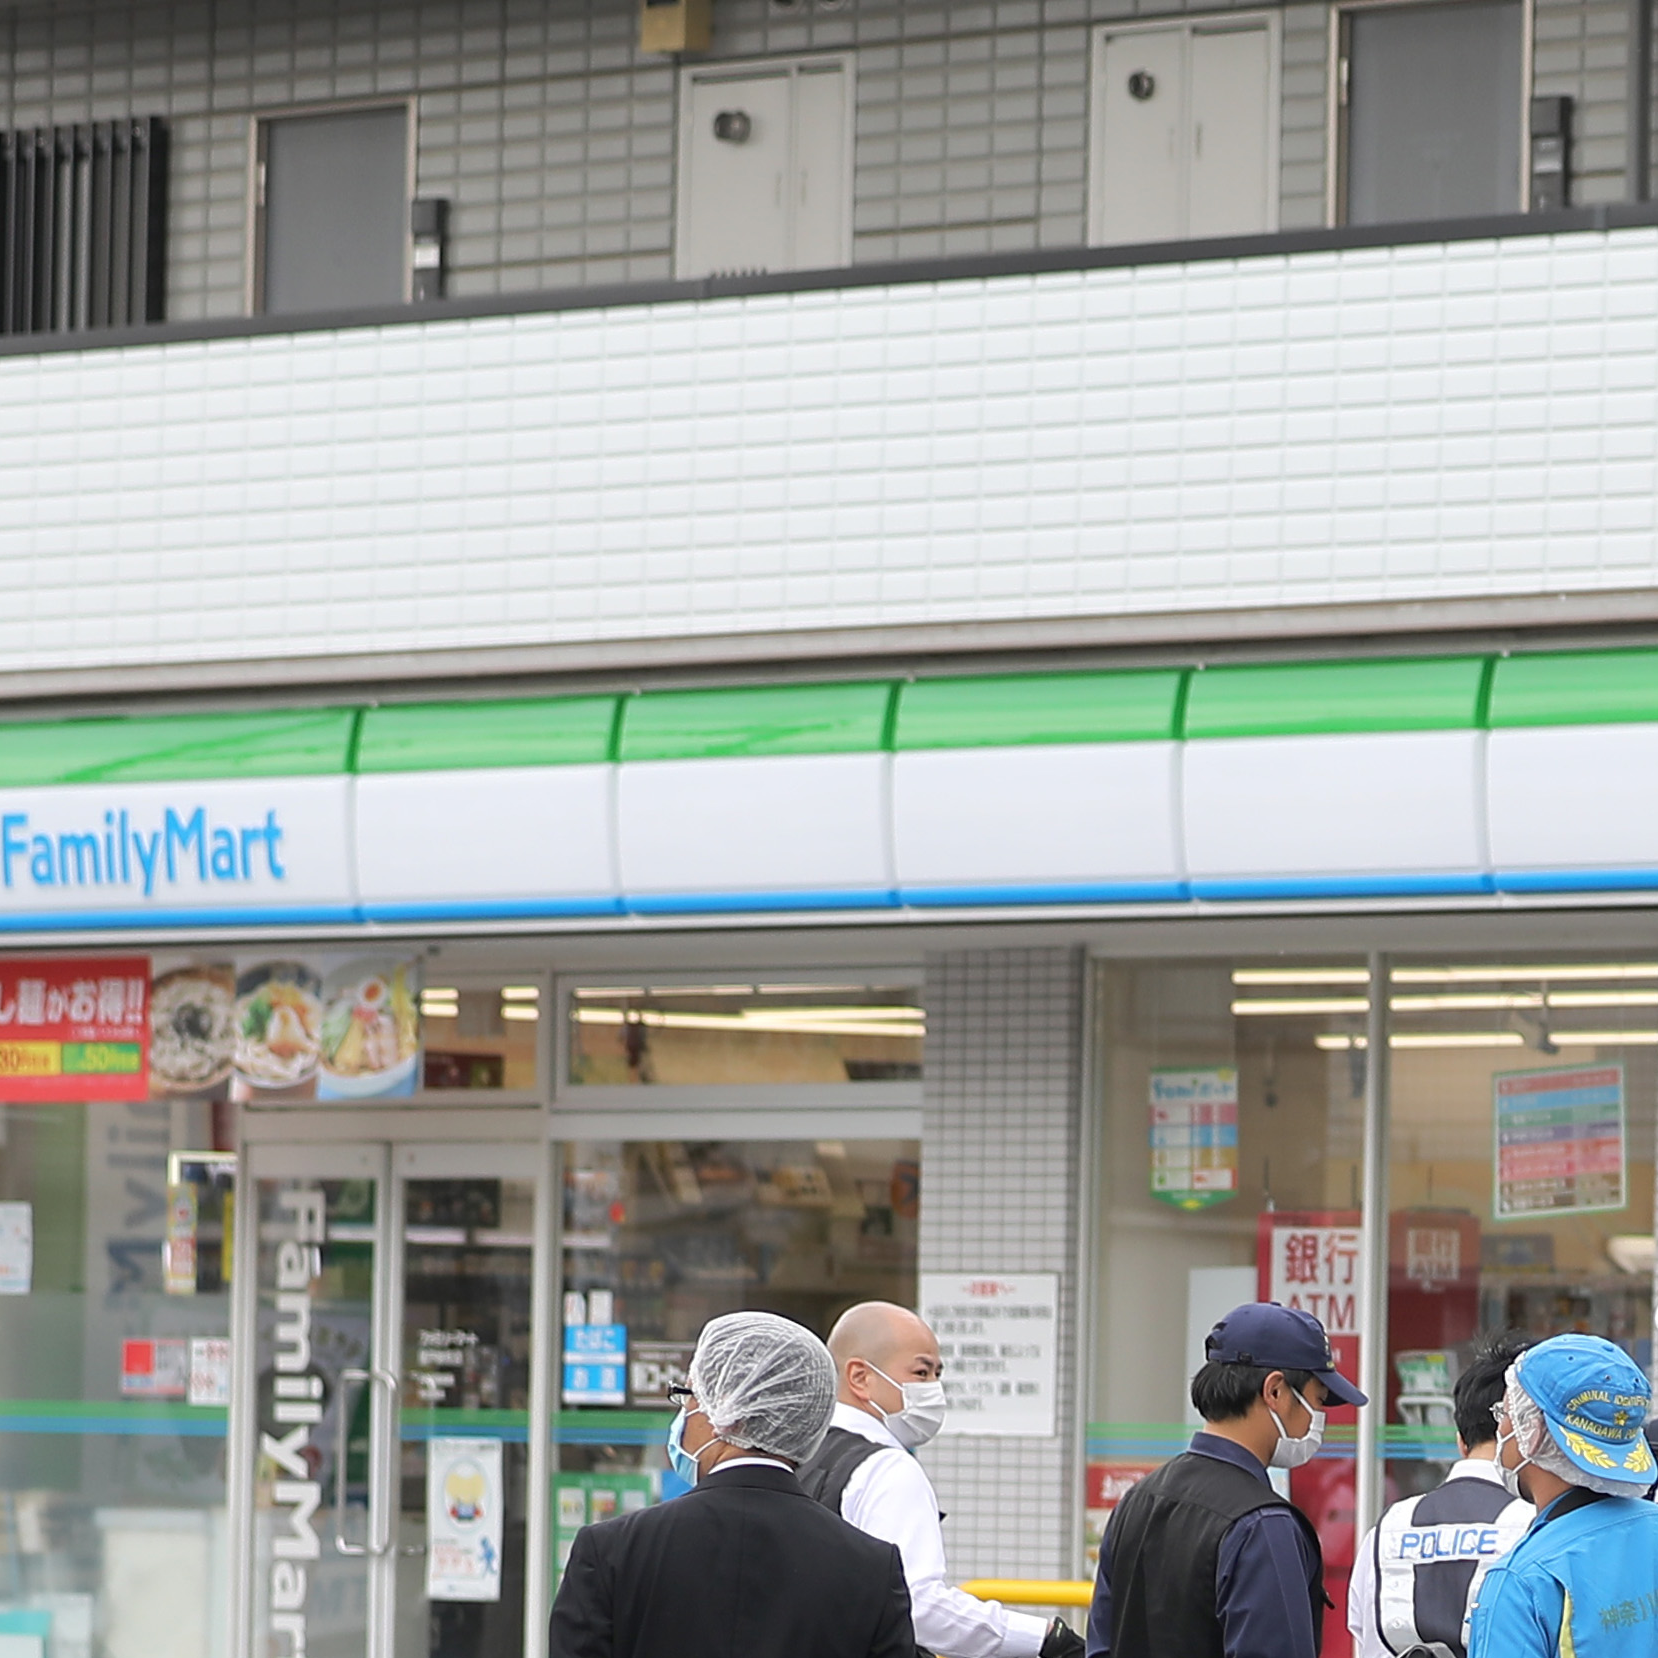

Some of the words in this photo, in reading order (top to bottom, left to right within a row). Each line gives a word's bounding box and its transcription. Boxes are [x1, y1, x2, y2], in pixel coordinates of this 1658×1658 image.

[1, 806, 285, 897] FamilyMart
[1285, 1234, 1359, 1284] 銀行
[1565, 1412, 1623, 1439] KANAGAWA
[1399, 1528, 1499, 1559] POLICE
